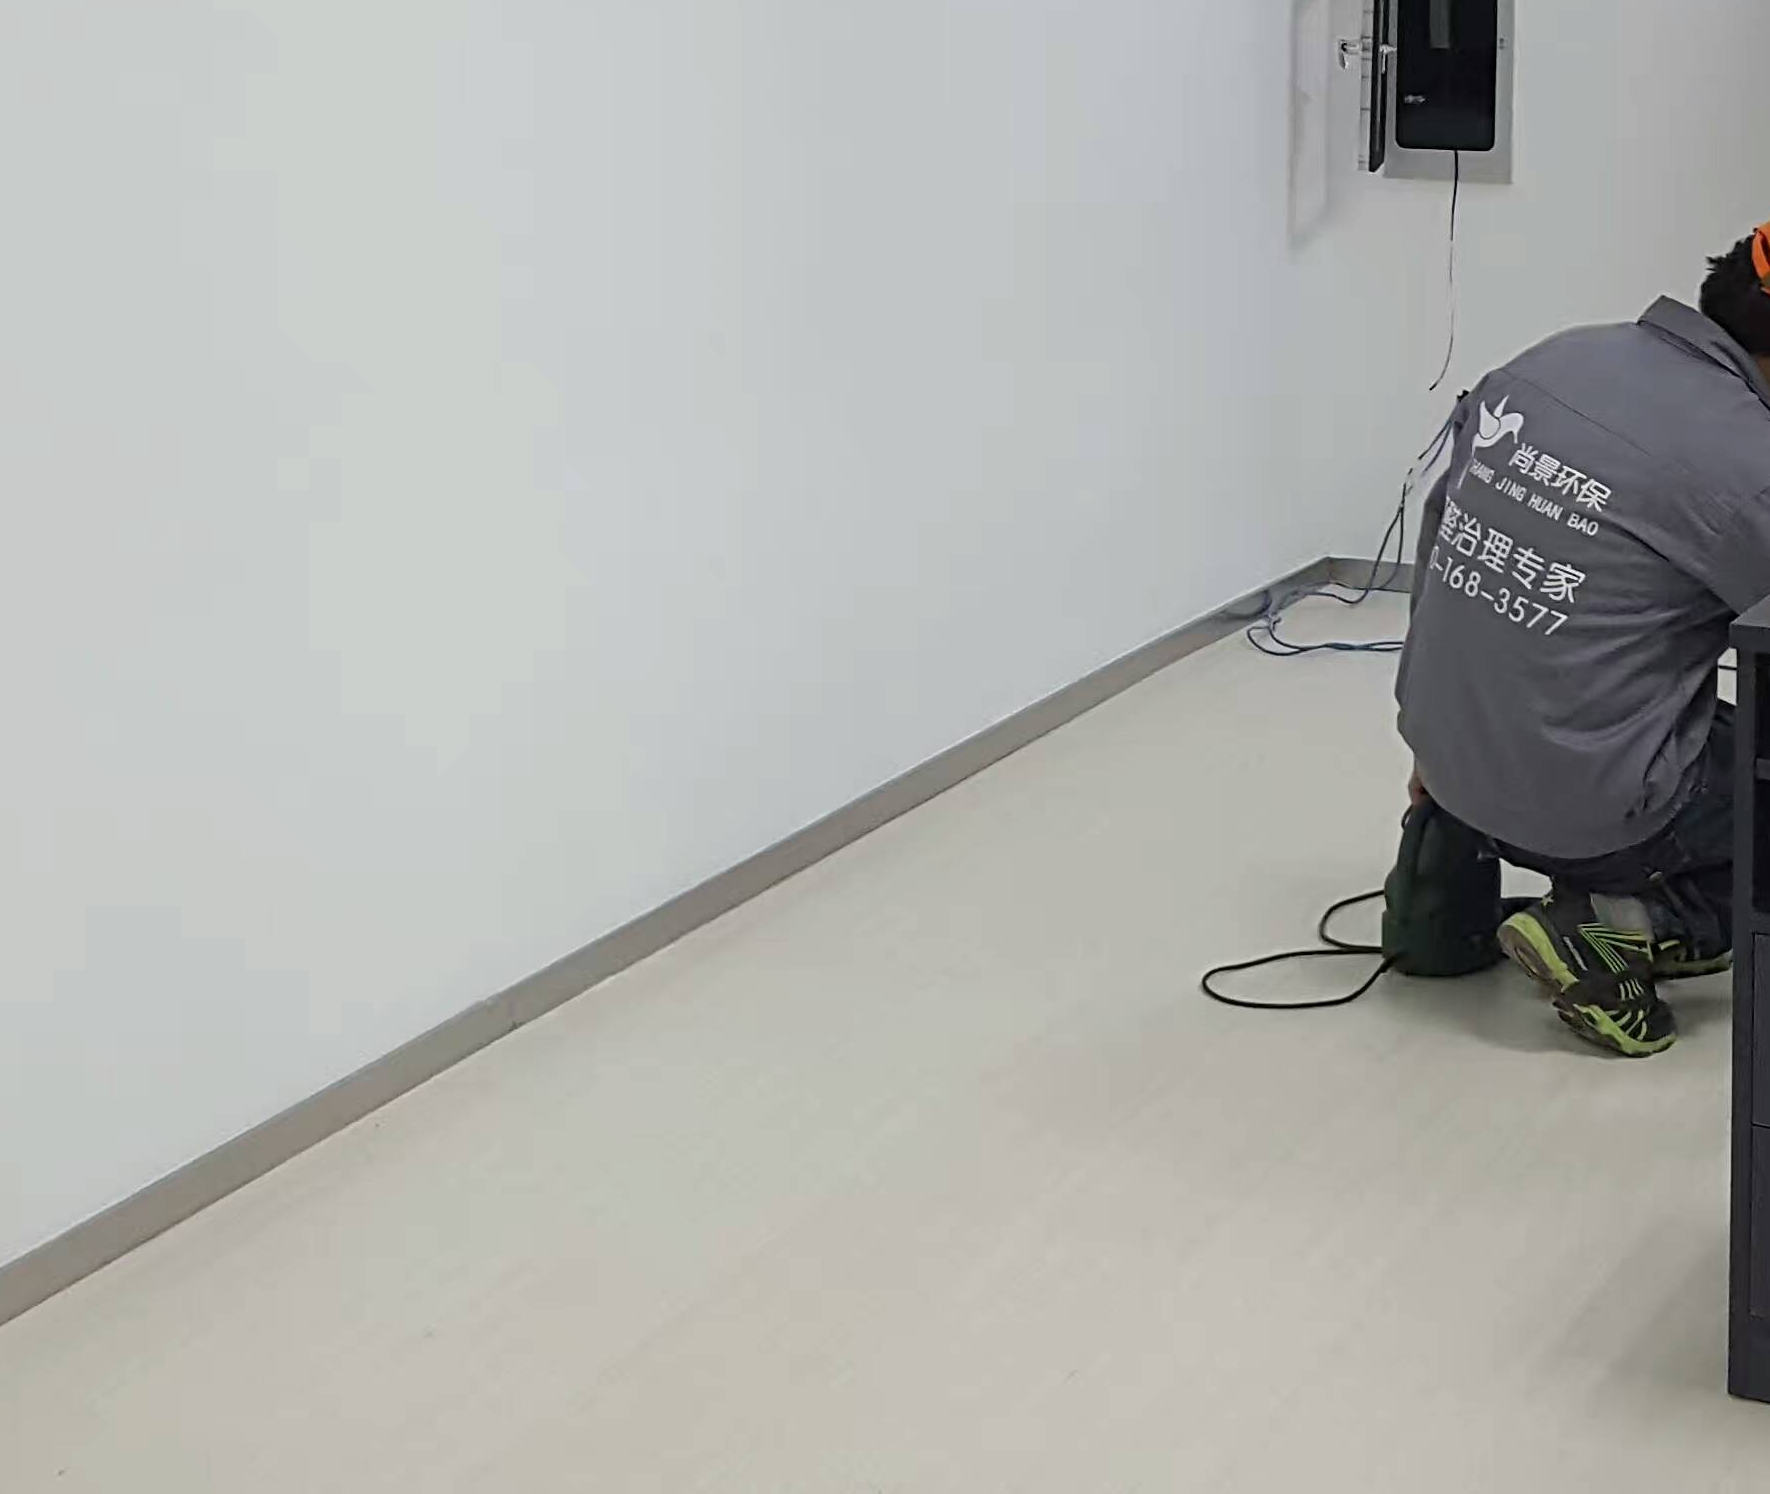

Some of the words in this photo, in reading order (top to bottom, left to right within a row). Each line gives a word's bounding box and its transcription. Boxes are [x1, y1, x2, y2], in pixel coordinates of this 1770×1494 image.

[1496, 477, 1526, 502] JING
[1527, 495, 1564, 521] HUAN
[1567, 515, 1599, 537] BAO
[1509, 444, 1612, 512] 尚景环保
